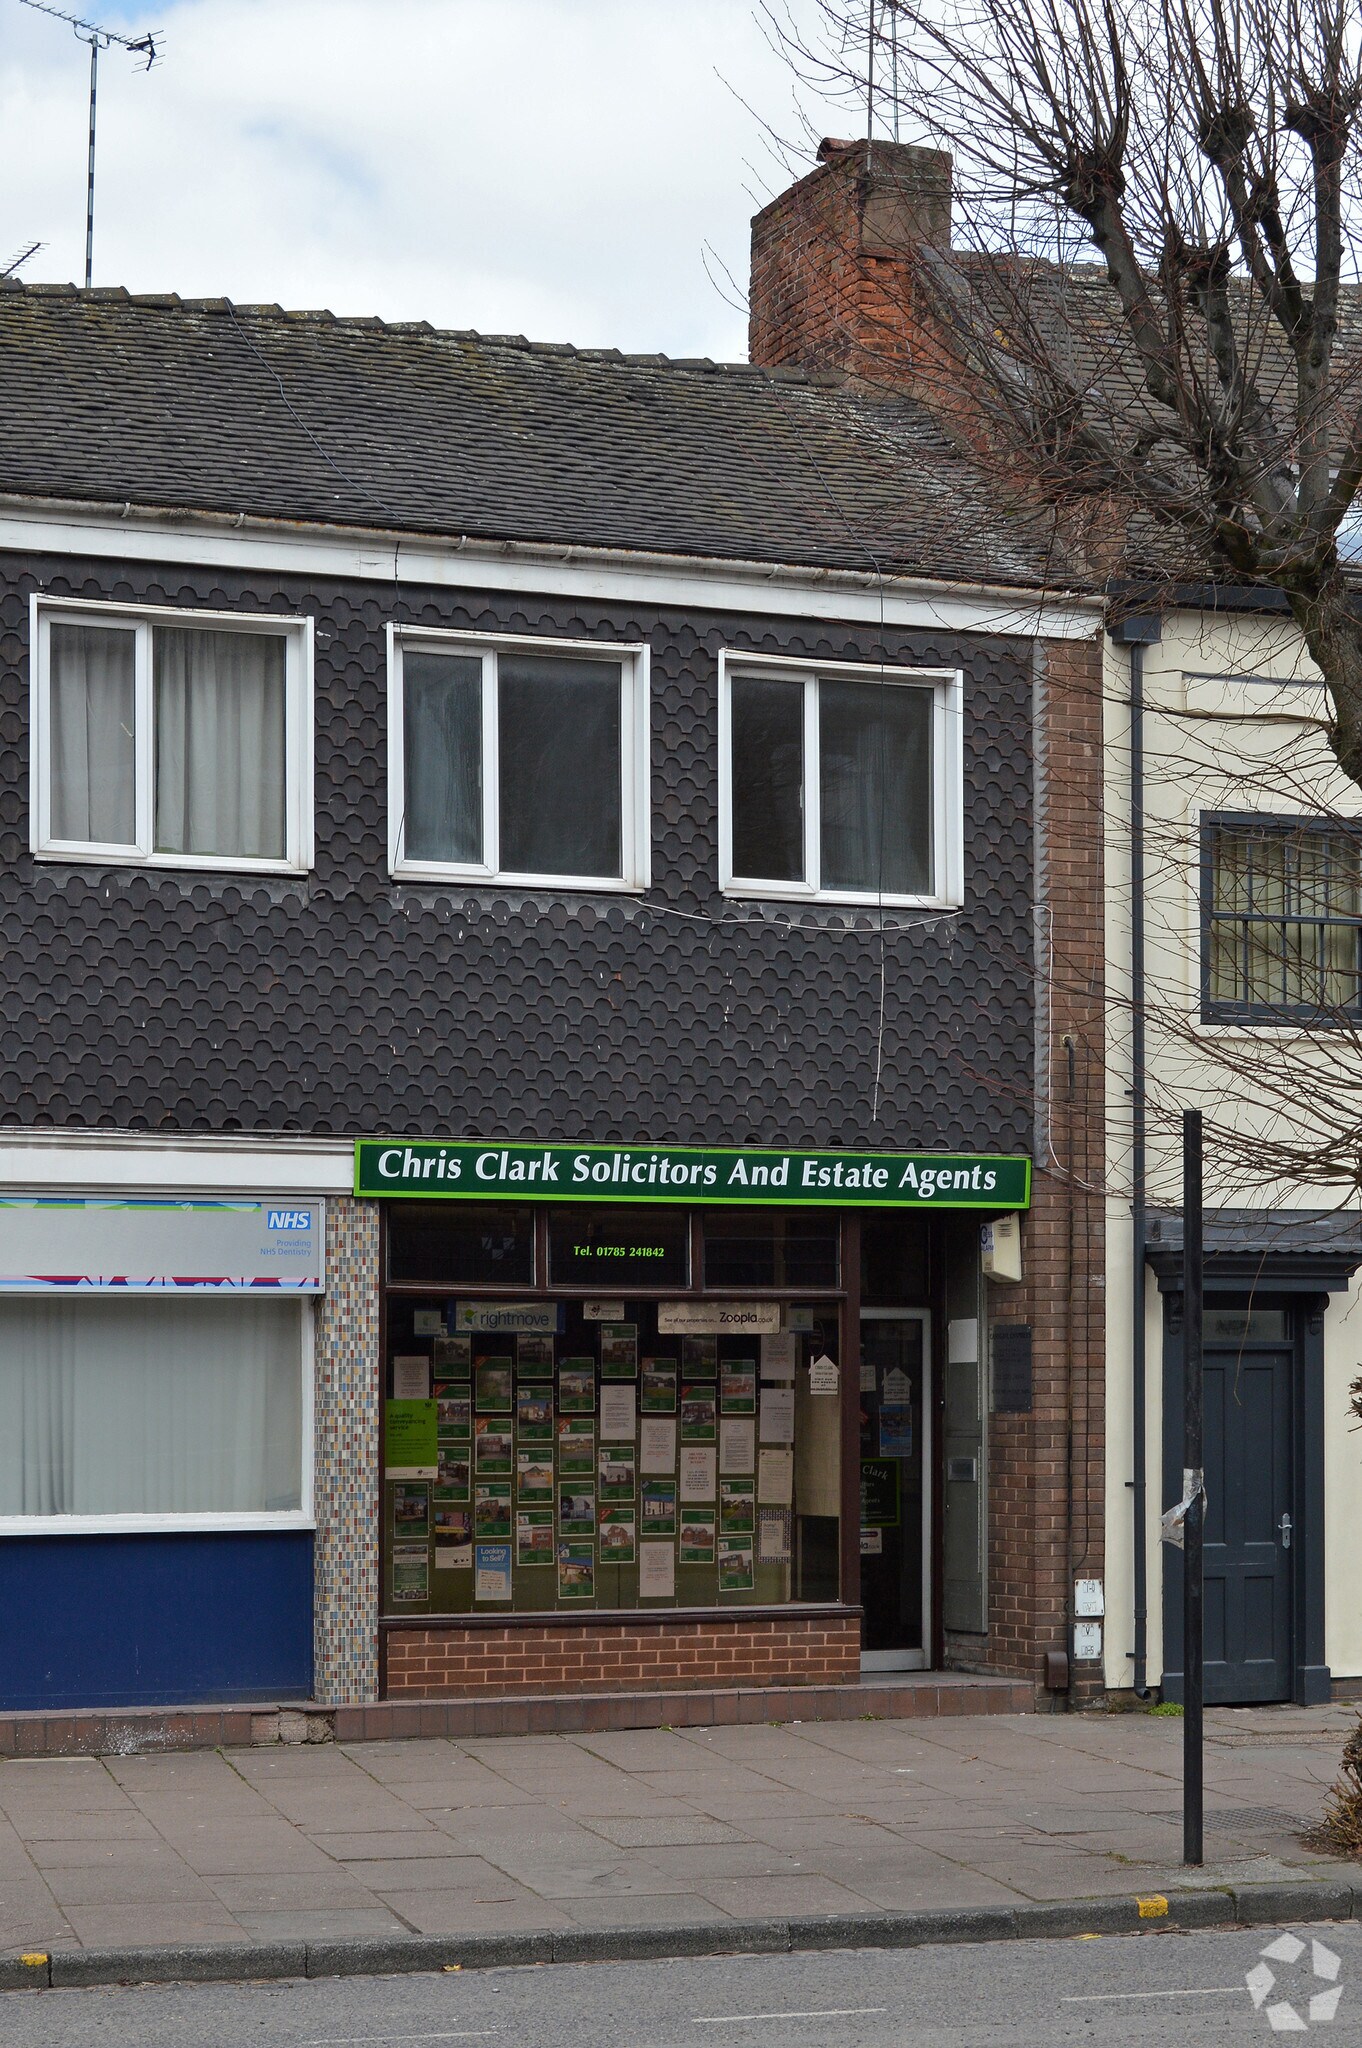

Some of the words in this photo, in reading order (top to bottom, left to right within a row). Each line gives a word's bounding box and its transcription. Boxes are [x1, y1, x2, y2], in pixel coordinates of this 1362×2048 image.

[378, 1149, 462, 1179] Chris
[475, 1151, 560, 1181] Clark
[572, 1153, 717, 1185] Solicitors
[727, 1157, 790, 1186] And
[801, 1160, 889, 1188] Estate
[898, 1162, 997, 1198] Agents
[268, 1212, 310, 1229] NHS
[276, 1239, 312, 1248] Providing
[277, 1248, 312, 1257] Dentistry
[573, 1245, 593, 1256] Tel.
[596, 1246, 626, 1257] 01785
[628, 1247, 665, 1257] 241842
[480, 1310, 550, 1329] rightmove
[861, 1464, 889, 1481] Clark
[480, 1547, 507, 1555] Looking
